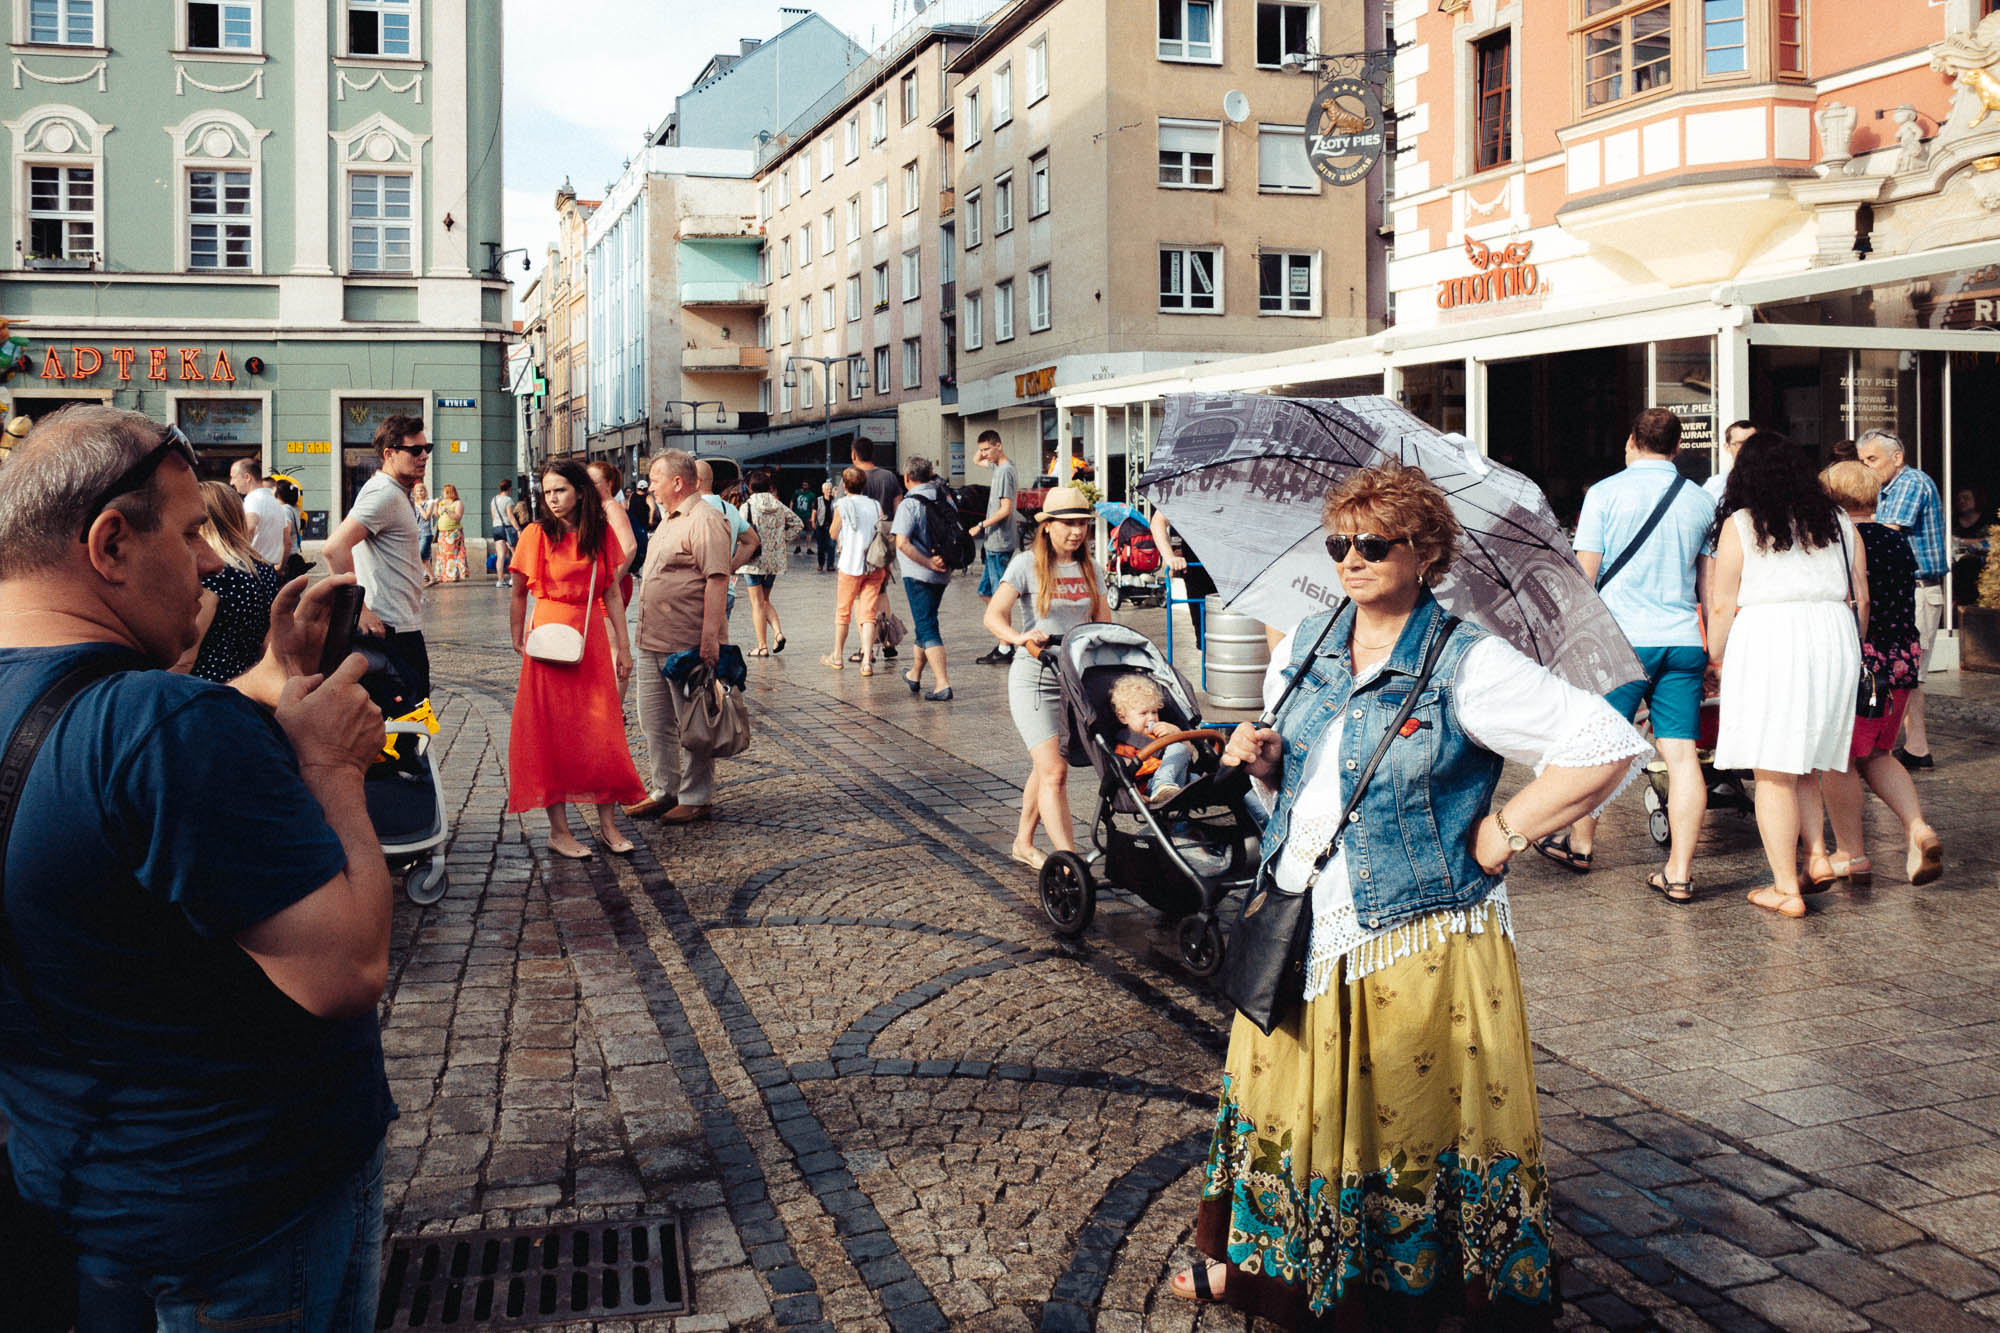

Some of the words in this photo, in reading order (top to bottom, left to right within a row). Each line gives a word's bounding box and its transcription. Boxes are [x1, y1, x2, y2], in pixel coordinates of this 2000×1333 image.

[1310, 134, 1350, 157] ZŁOTY
[1353, 133, 1381, 147] PIES
[1317, 161, 1337, 181] MINI
[1339, 158, 1373, 182] BROWAR
[40, 345, 236, 381] APTEKA
[1875, 378, 1898, 387] PIES
[445, 399, 468, 407] RYNEK
[1692, 403, 1716, 413] PIES
